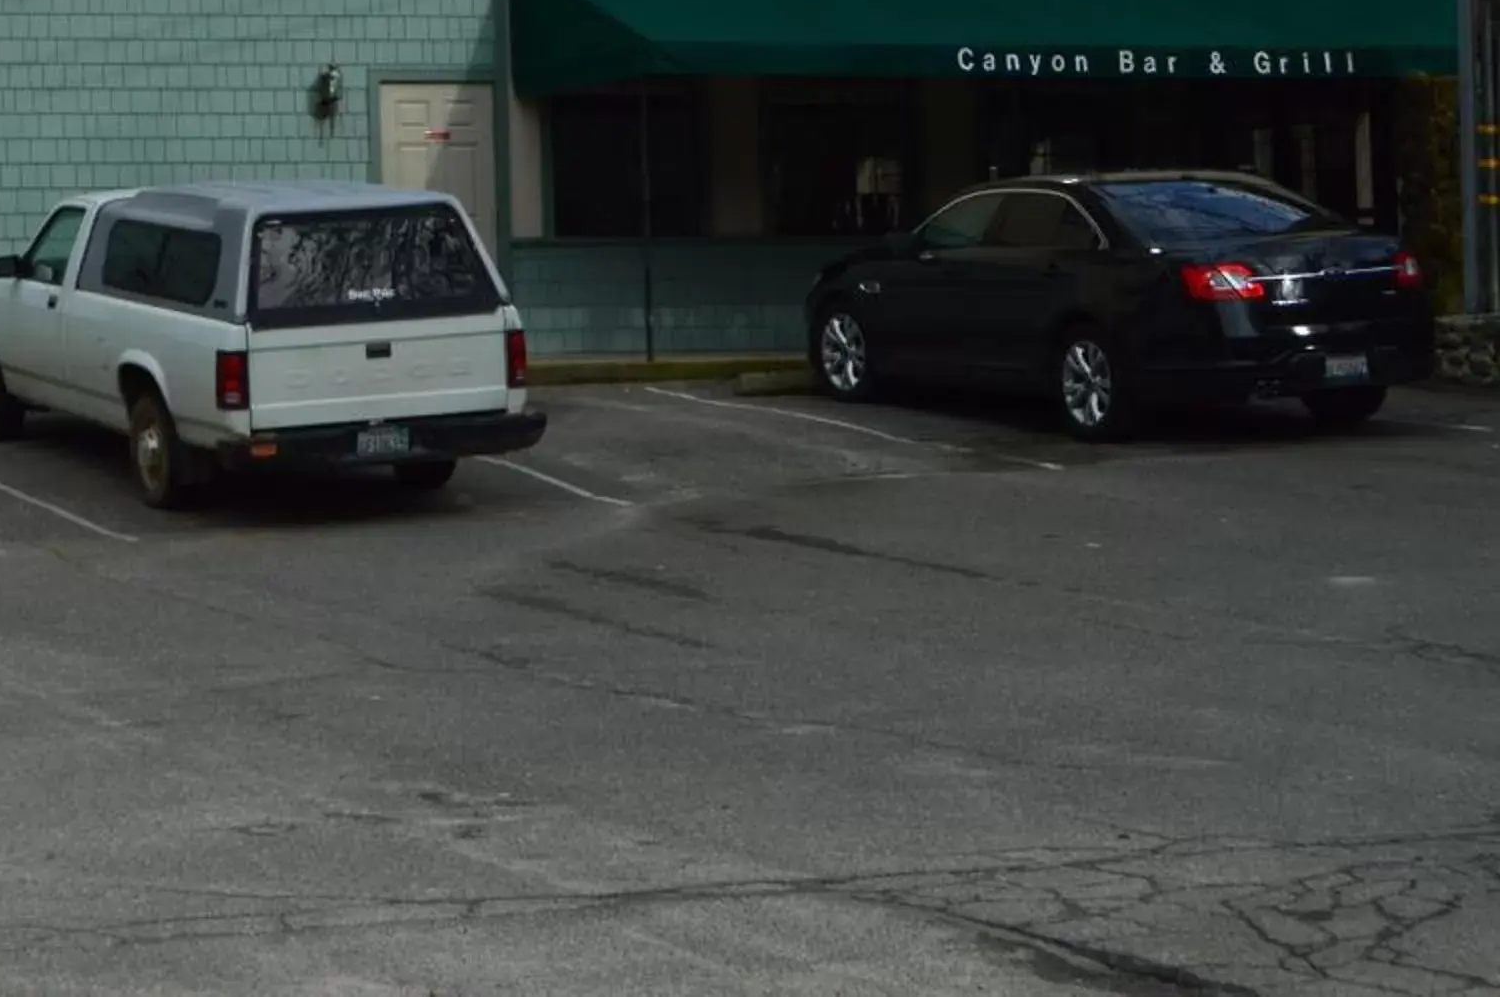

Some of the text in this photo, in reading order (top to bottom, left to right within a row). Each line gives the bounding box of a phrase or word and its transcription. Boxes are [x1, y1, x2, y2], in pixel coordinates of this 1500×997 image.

[957, 46, 1355, 75] Canyon Bar & Grill
